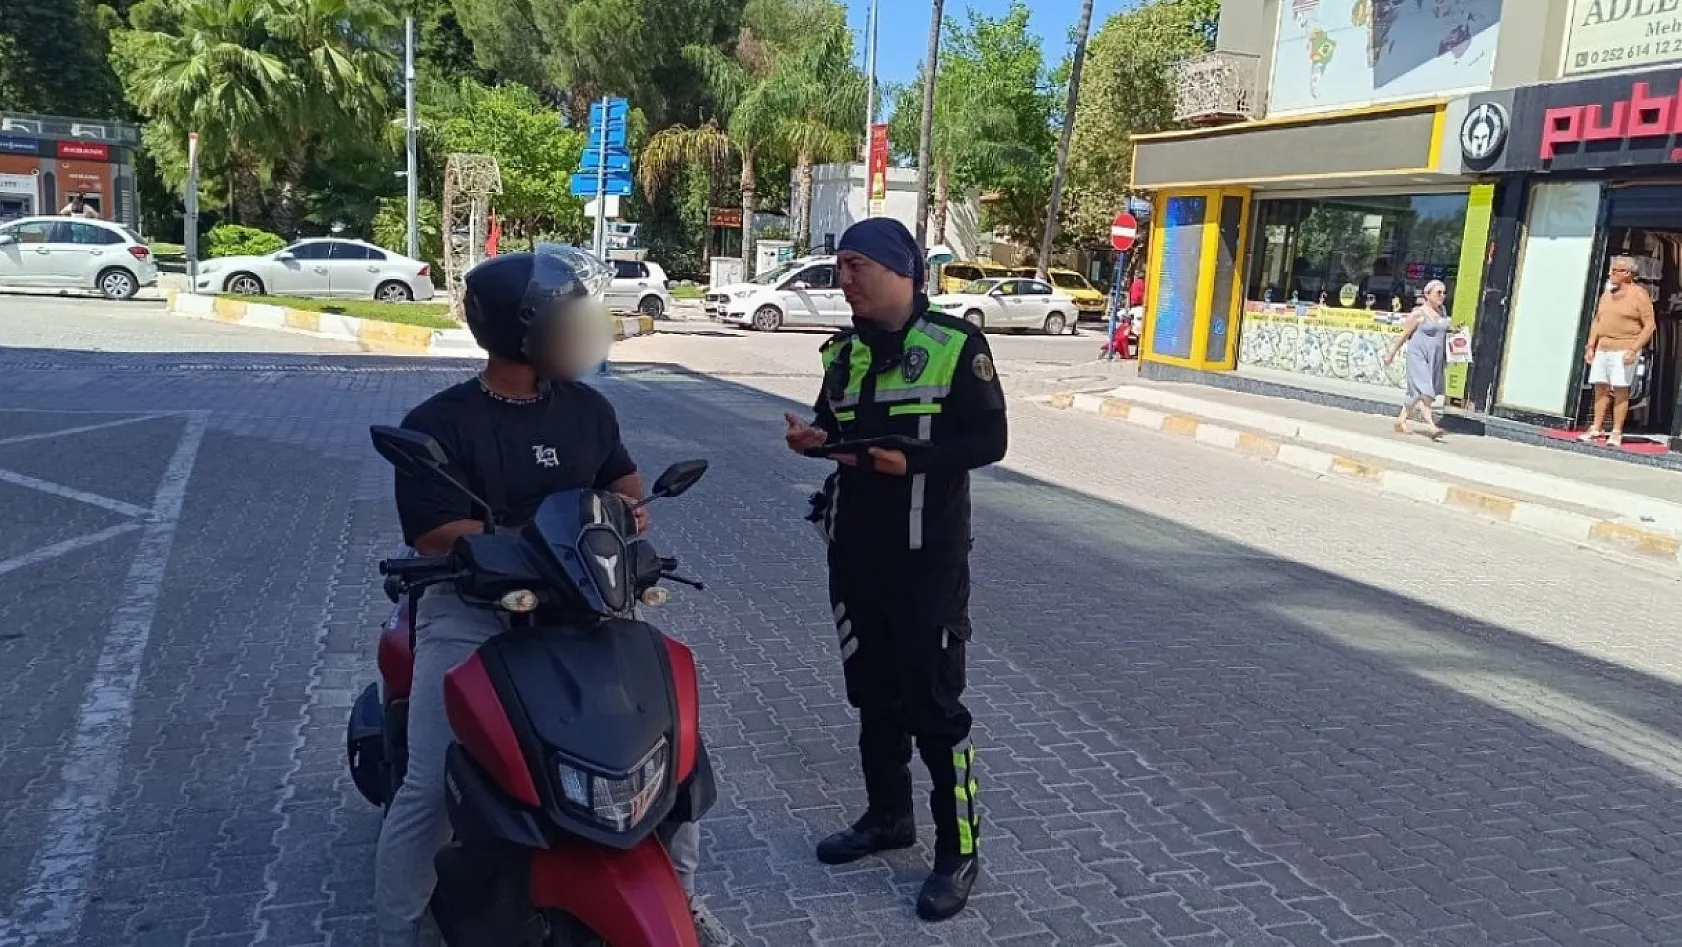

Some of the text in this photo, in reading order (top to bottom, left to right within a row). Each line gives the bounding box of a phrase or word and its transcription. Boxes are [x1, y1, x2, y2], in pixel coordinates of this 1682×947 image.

[1591, 51, 1599, 64] 0
[1602, 47, 1624, 62] 252
[1627, 44, 1650, 59] 614
[1655, 40, 1670, 54] 12
